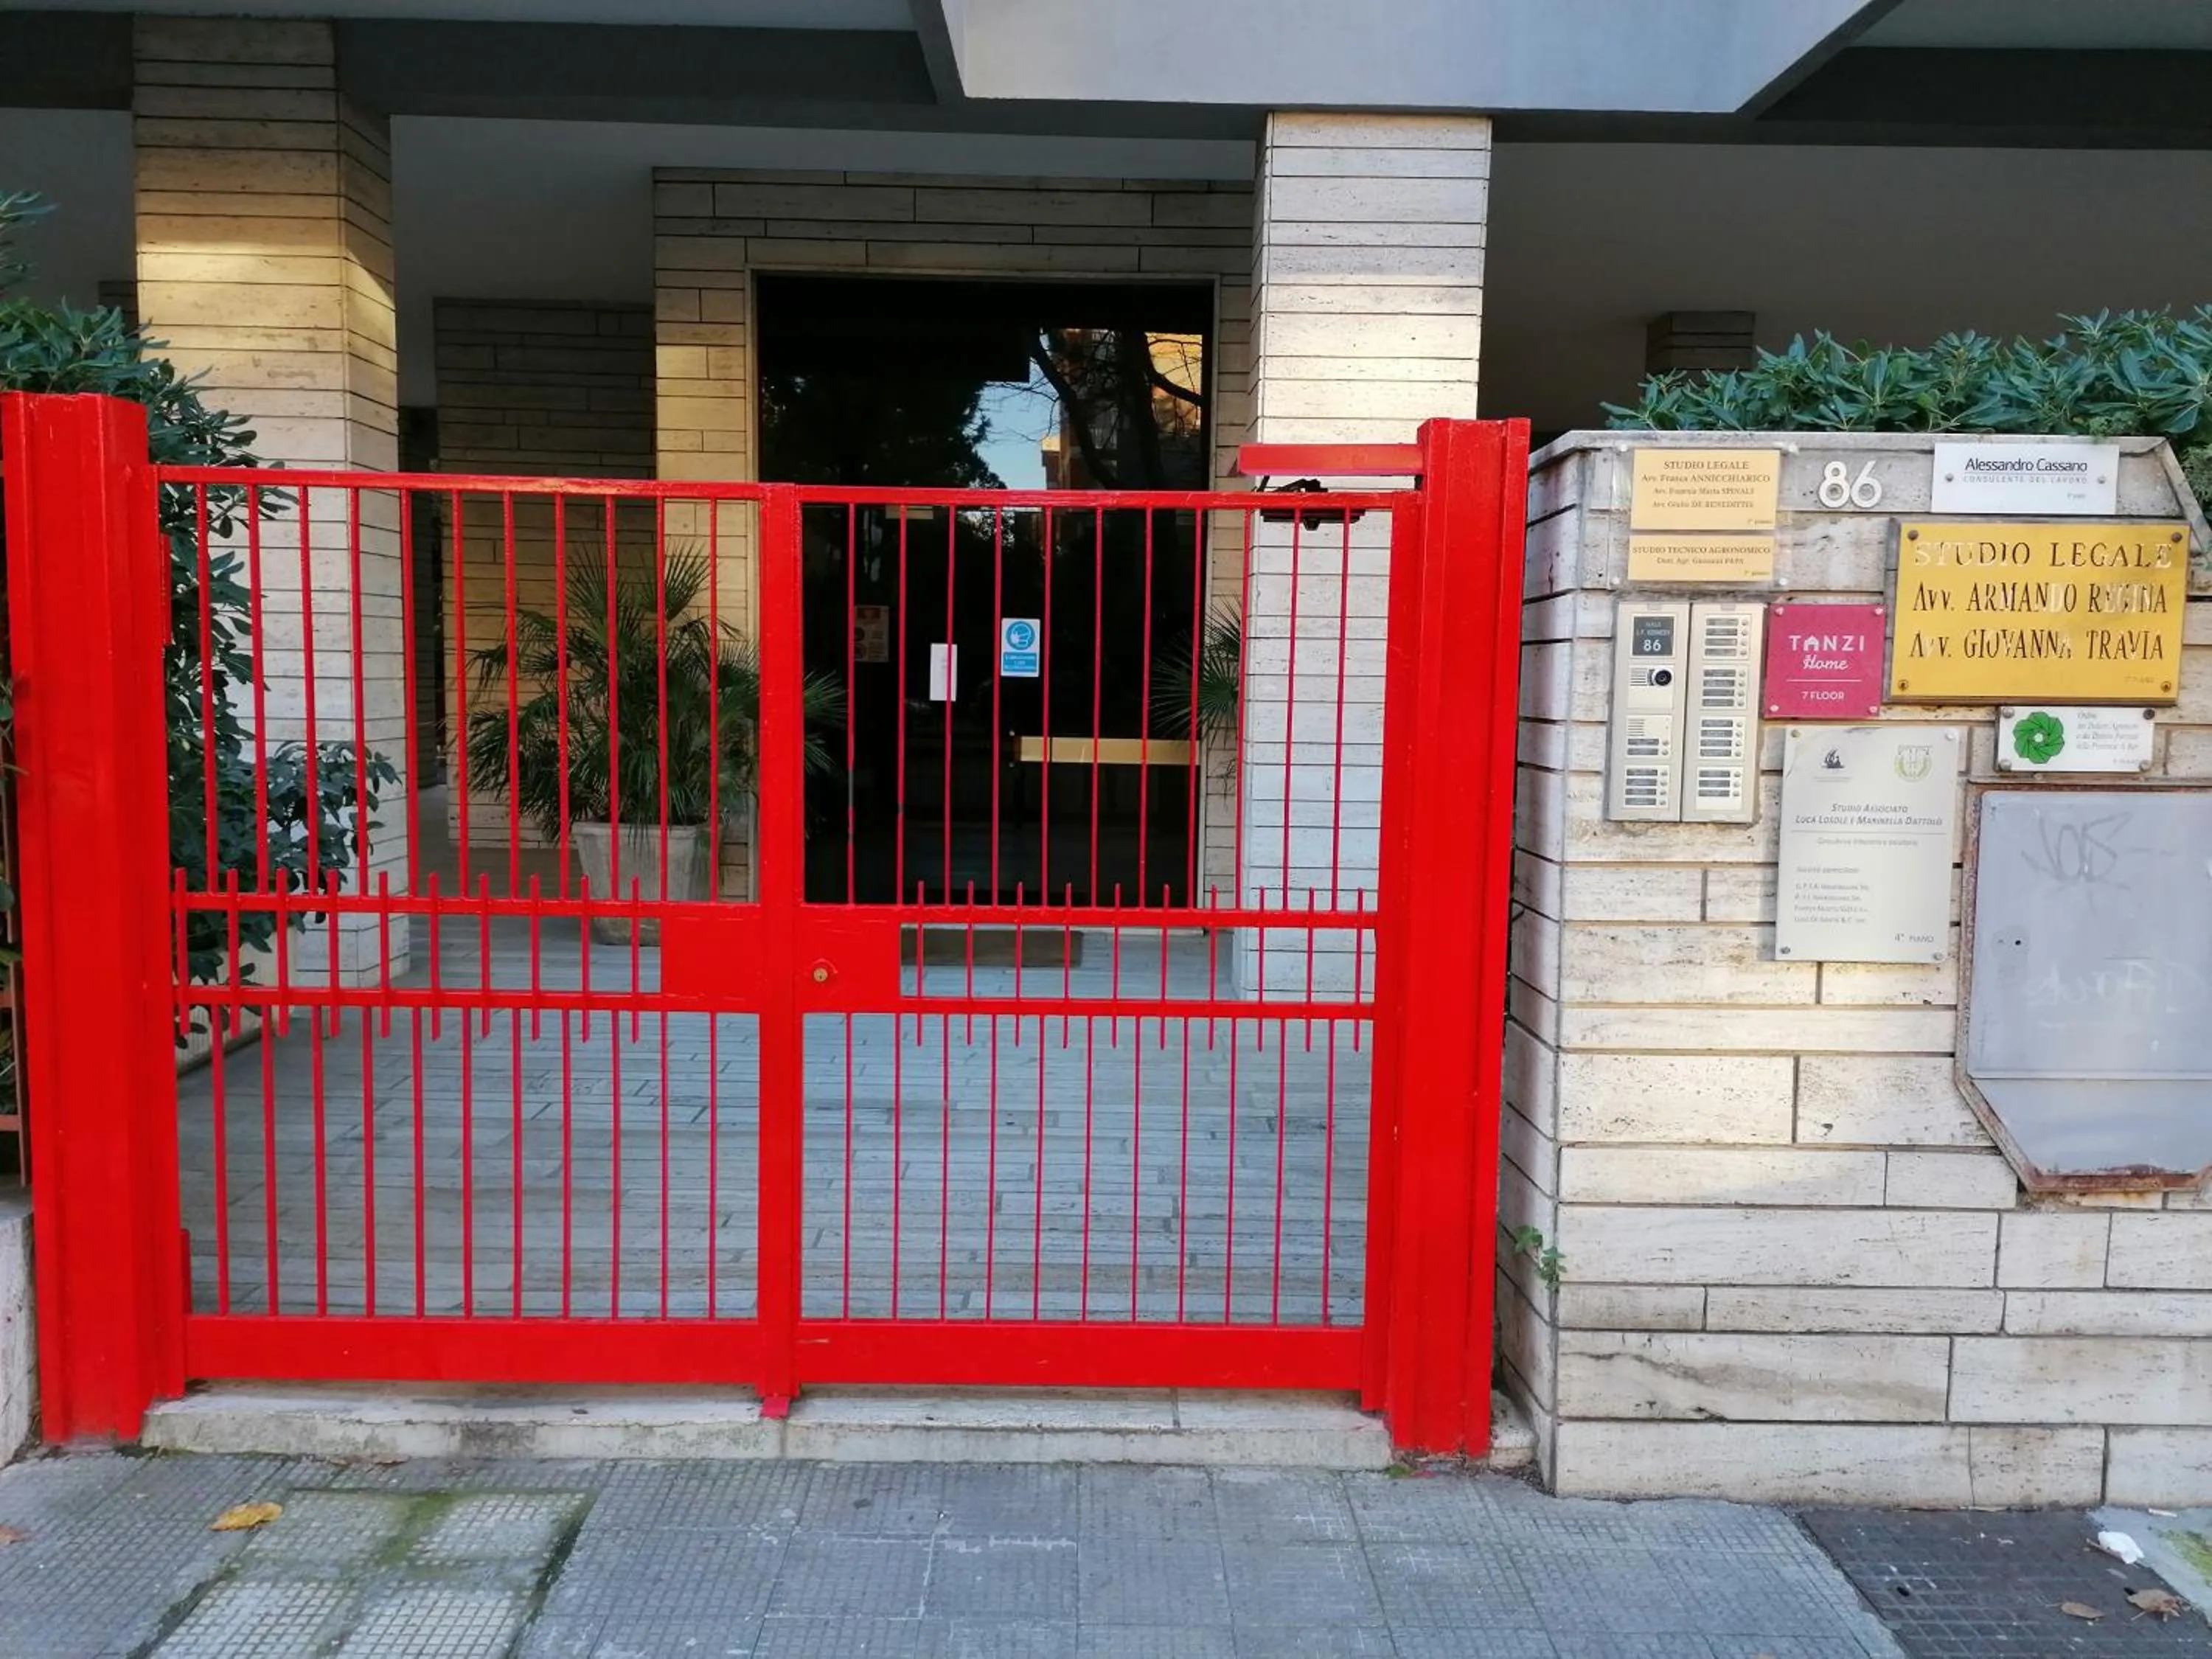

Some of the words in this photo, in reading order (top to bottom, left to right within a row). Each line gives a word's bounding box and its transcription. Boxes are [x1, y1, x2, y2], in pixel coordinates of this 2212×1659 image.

[1663, 461, 1704, 470] STUDIO
[1707, 461, 1750, 470] LEGALE
[1964, 457, 2034, 472] Alessandro
[2037, 457, 2088, 473] Cassano
[1690, 474, 1770, 483] ANNICCHIARICO
[1818, 460, 1882, 509] 86
[1632, 546, 1666, 554] STUDIO
[1667, 546, 1708, 554] TECNICO
[1708, 546, 1770, 554] AGRONOMICO
[1914, 540, 2031, 568] STUDIO
[2049, 540, 2172, 569] LEGALE
[1966, 582, 2077, 614] ARMANDO
[2087, 583, 2168, 614] REGINA
[1644, 639, 1661, 652] 86
[1788, 635, 1865, 652] TANZI
[1963, 628, 2073, 660] GIOVANNA
[2085, 630, 2163, 661] TRAVIA
[1802, 654, 1849, 670] Home
[1801, 691, 1809, 700] 7
[1810, 691, 1846, 700] FLOOR
